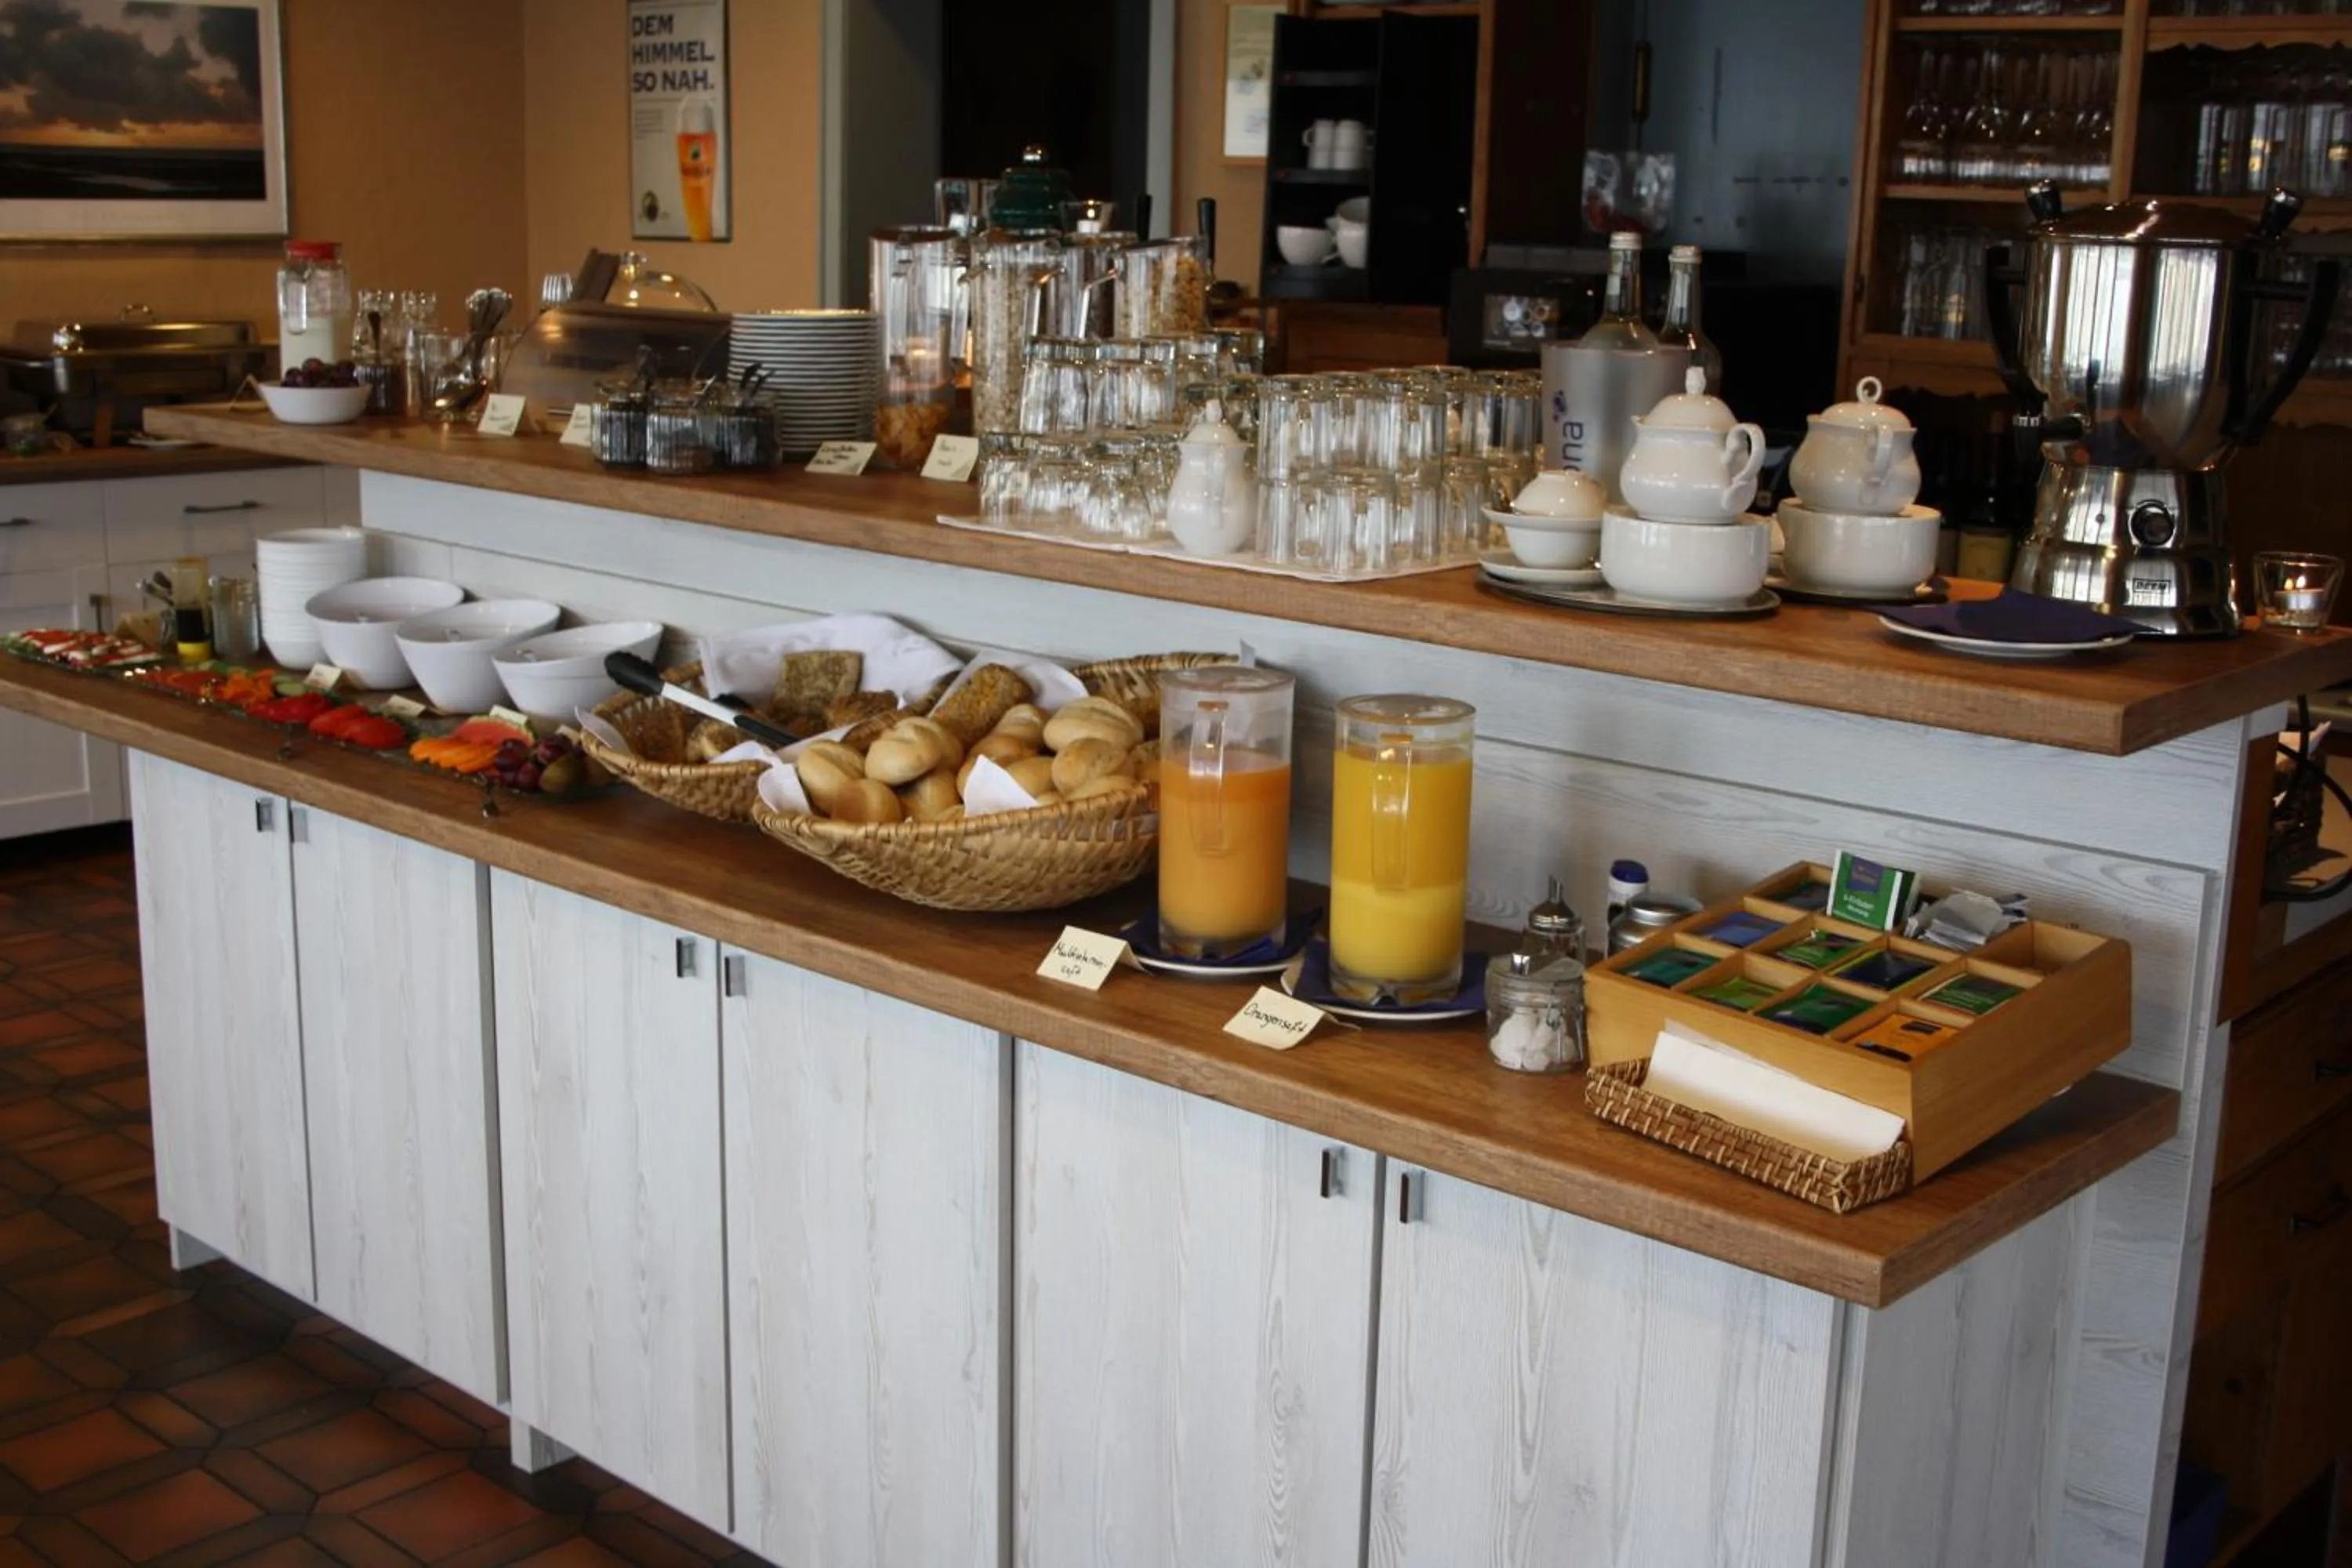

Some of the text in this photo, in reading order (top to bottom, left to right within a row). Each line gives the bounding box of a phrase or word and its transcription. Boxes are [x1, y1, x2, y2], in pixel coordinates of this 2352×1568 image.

[632, 14, 674, 37] DEM
[633, 68, 714, 93] SO NAH.
